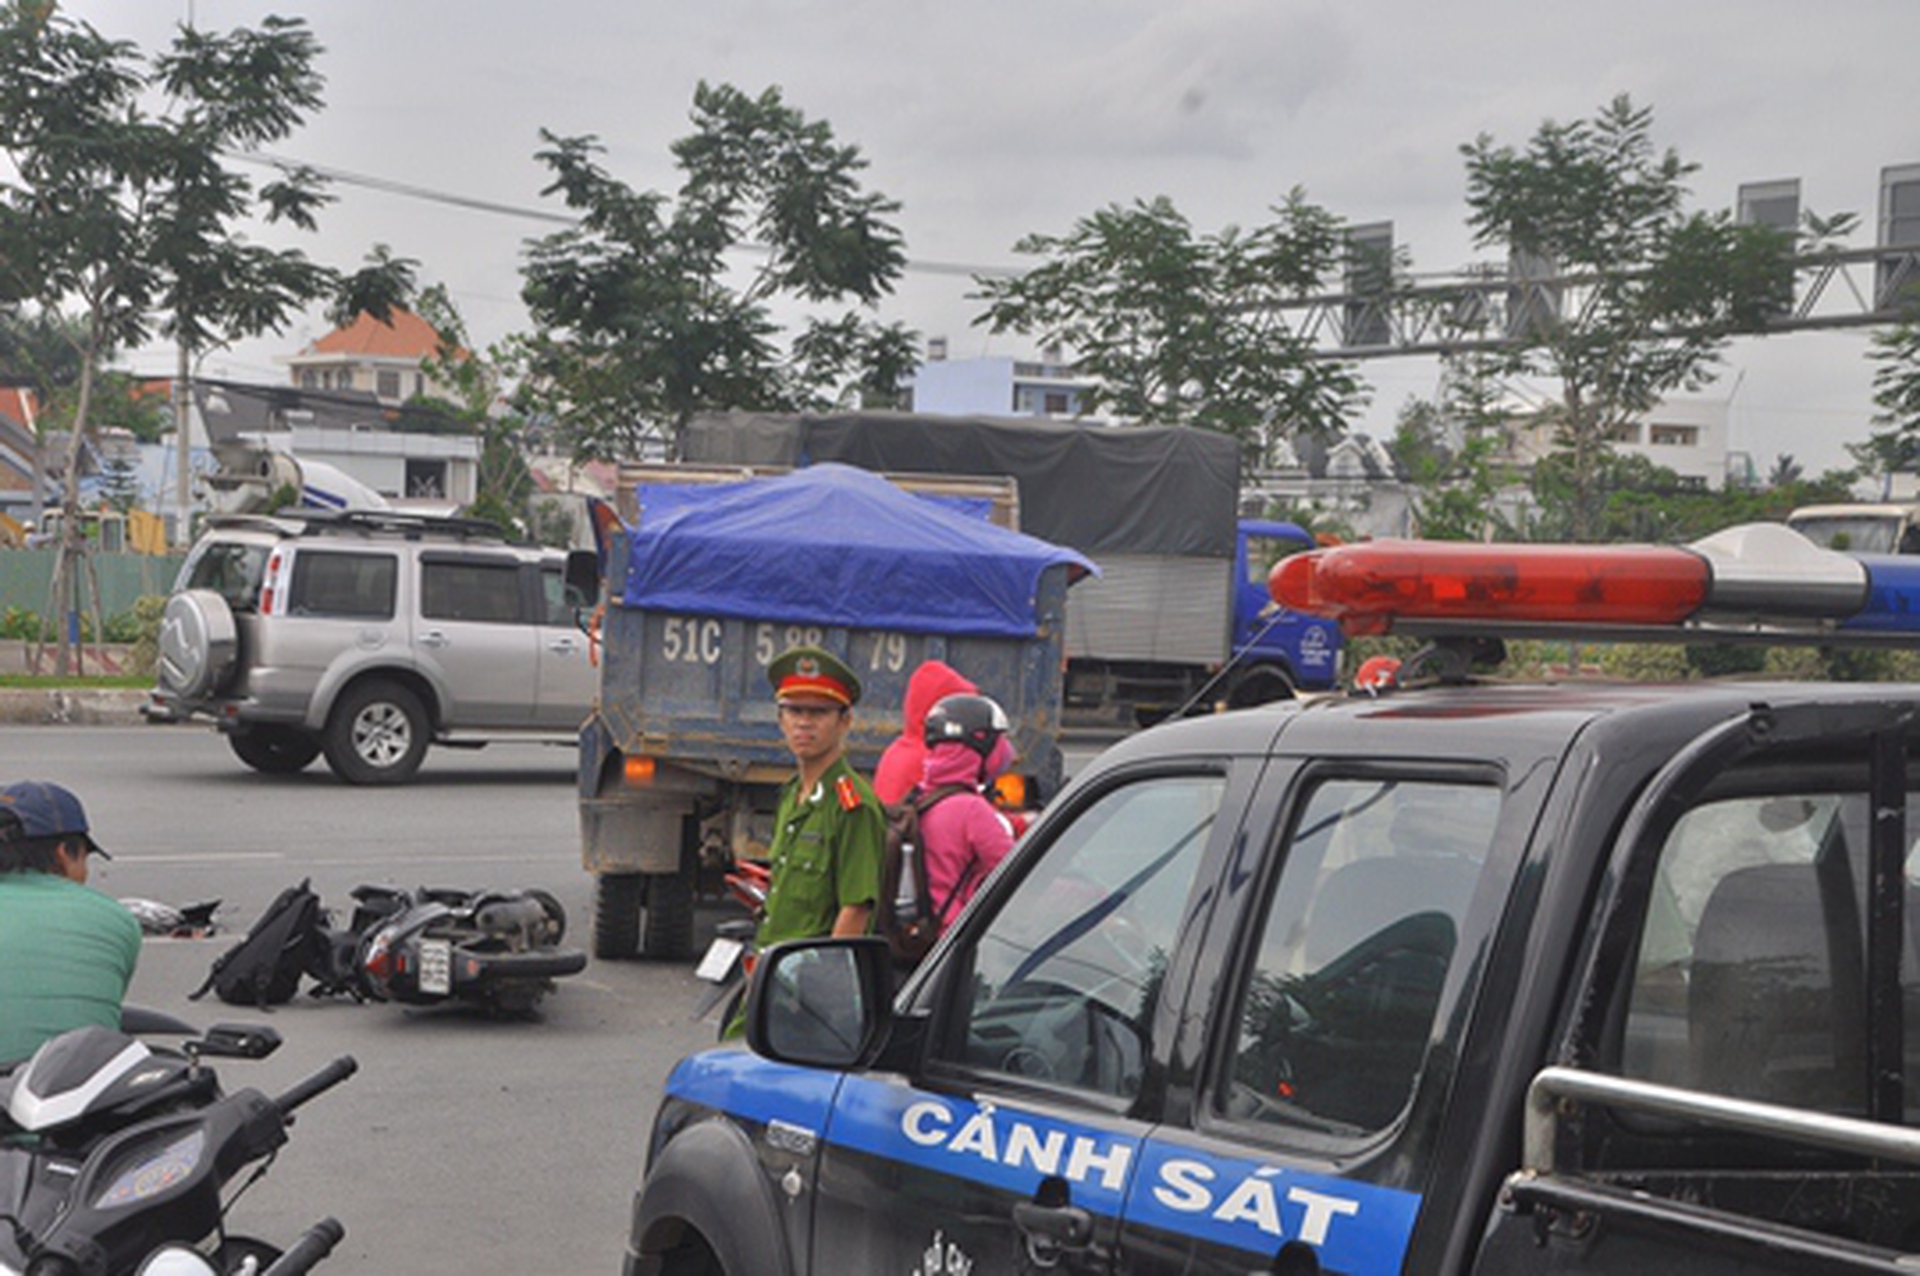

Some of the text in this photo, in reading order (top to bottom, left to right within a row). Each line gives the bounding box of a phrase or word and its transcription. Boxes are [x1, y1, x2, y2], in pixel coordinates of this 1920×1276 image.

[662, 618, 721, 664] 51C
[868, 632, 905, 673] 79
[902, 1100, 1360, 1246] CẢNH SÁT
